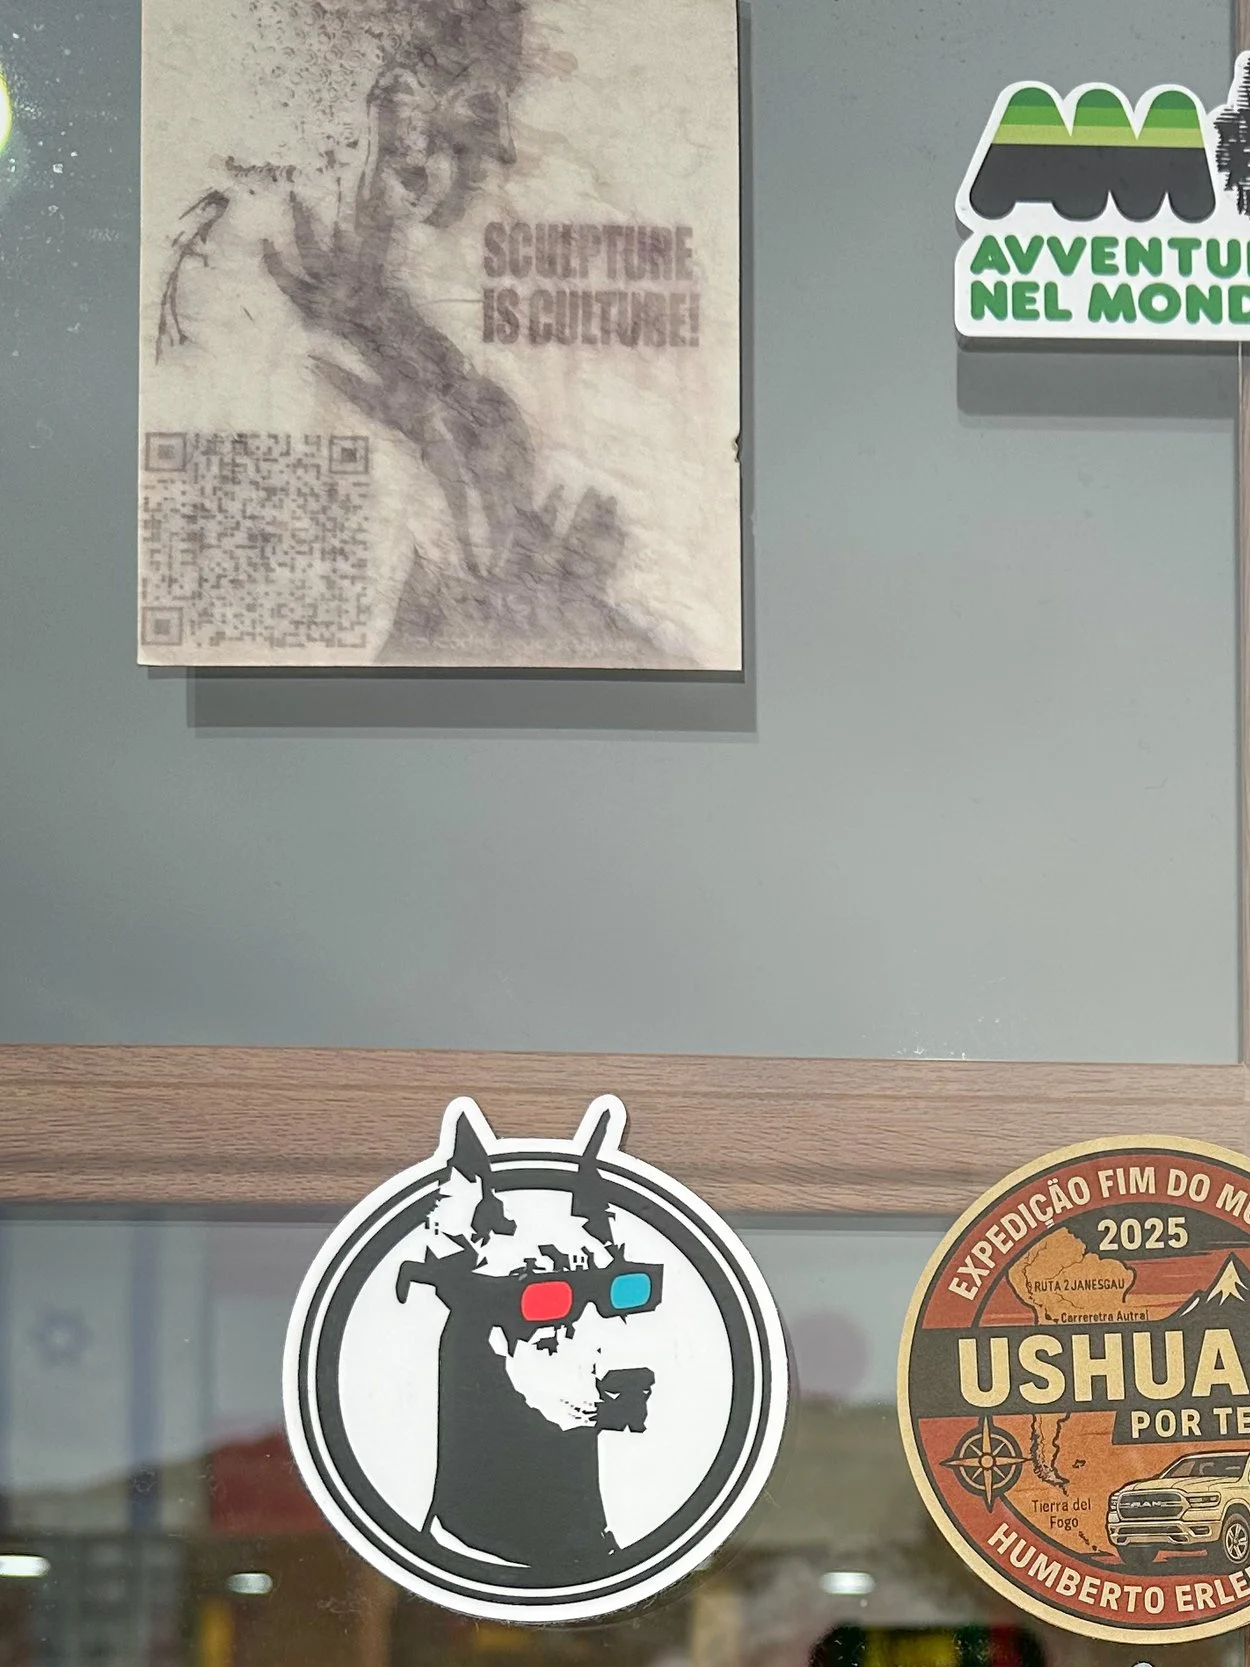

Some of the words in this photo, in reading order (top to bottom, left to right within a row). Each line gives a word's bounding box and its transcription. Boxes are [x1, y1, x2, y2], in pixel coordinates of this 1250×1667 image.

[483, 221, 693, 281] SCULPTURE
[482, 288, 520, 345] IS
[528, 289, 700, 347] CULTURE!
[970, 280, 1073, 321] NEL
[1097, 1165, 1157, 1201] FIM
[1167, 1167, 1212, 1203] DO
[1097, 1217, 1189, 1252] 2025
[1033, 1280, 1061, 1292] RUTA
[1130, 1408, 1202, 1440] POR
[1032, 1498, 1070, 1516] Tierra
[1073, 1498, 1092, 1513] del
[1049, 1514, 1080, 1532] Fogo
[987, 1521, 1165, 1615] HUMBERTO
